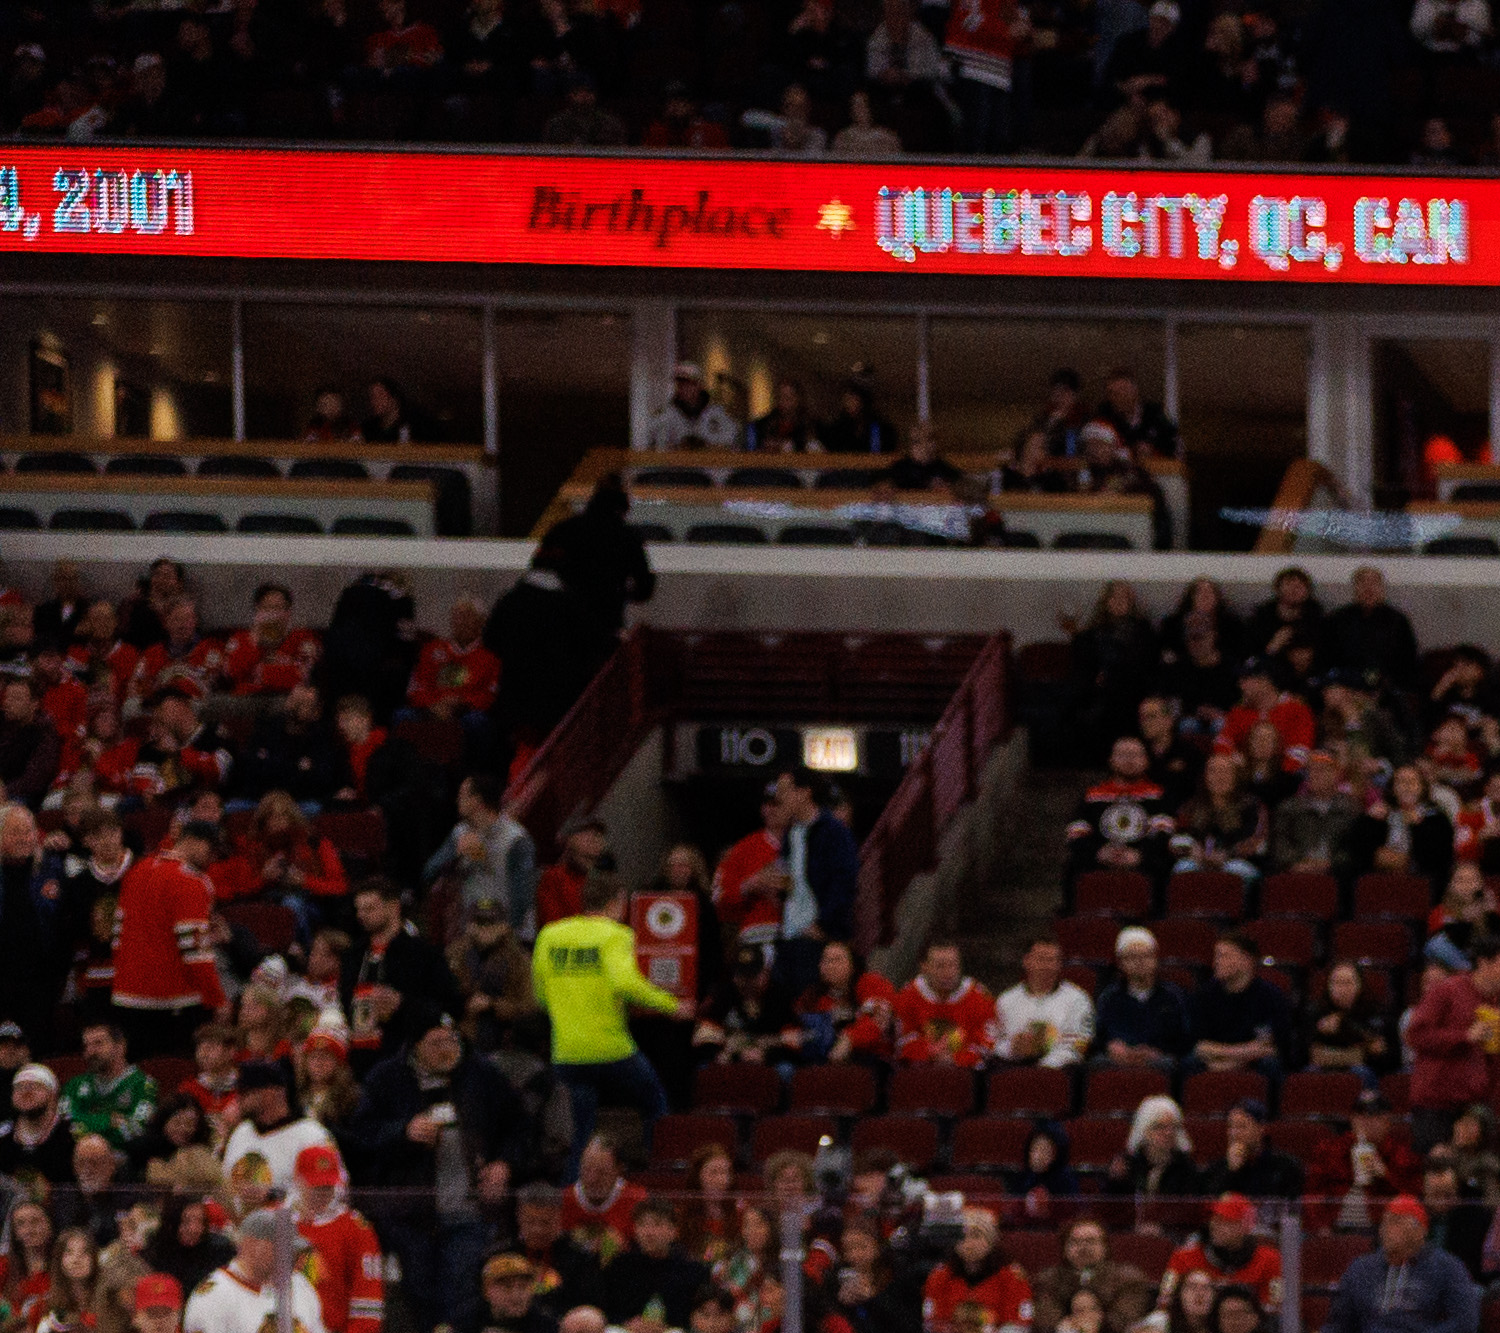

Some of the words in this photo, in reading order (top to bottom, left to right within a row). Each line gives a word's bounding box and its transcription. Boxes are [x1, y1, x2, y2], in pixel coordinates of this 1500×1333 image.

[529, 185, 794, 250] Birthplace
[875, 186, 1092, 263] QUEBEC
[1354, 196, 1472, 265] CAN
